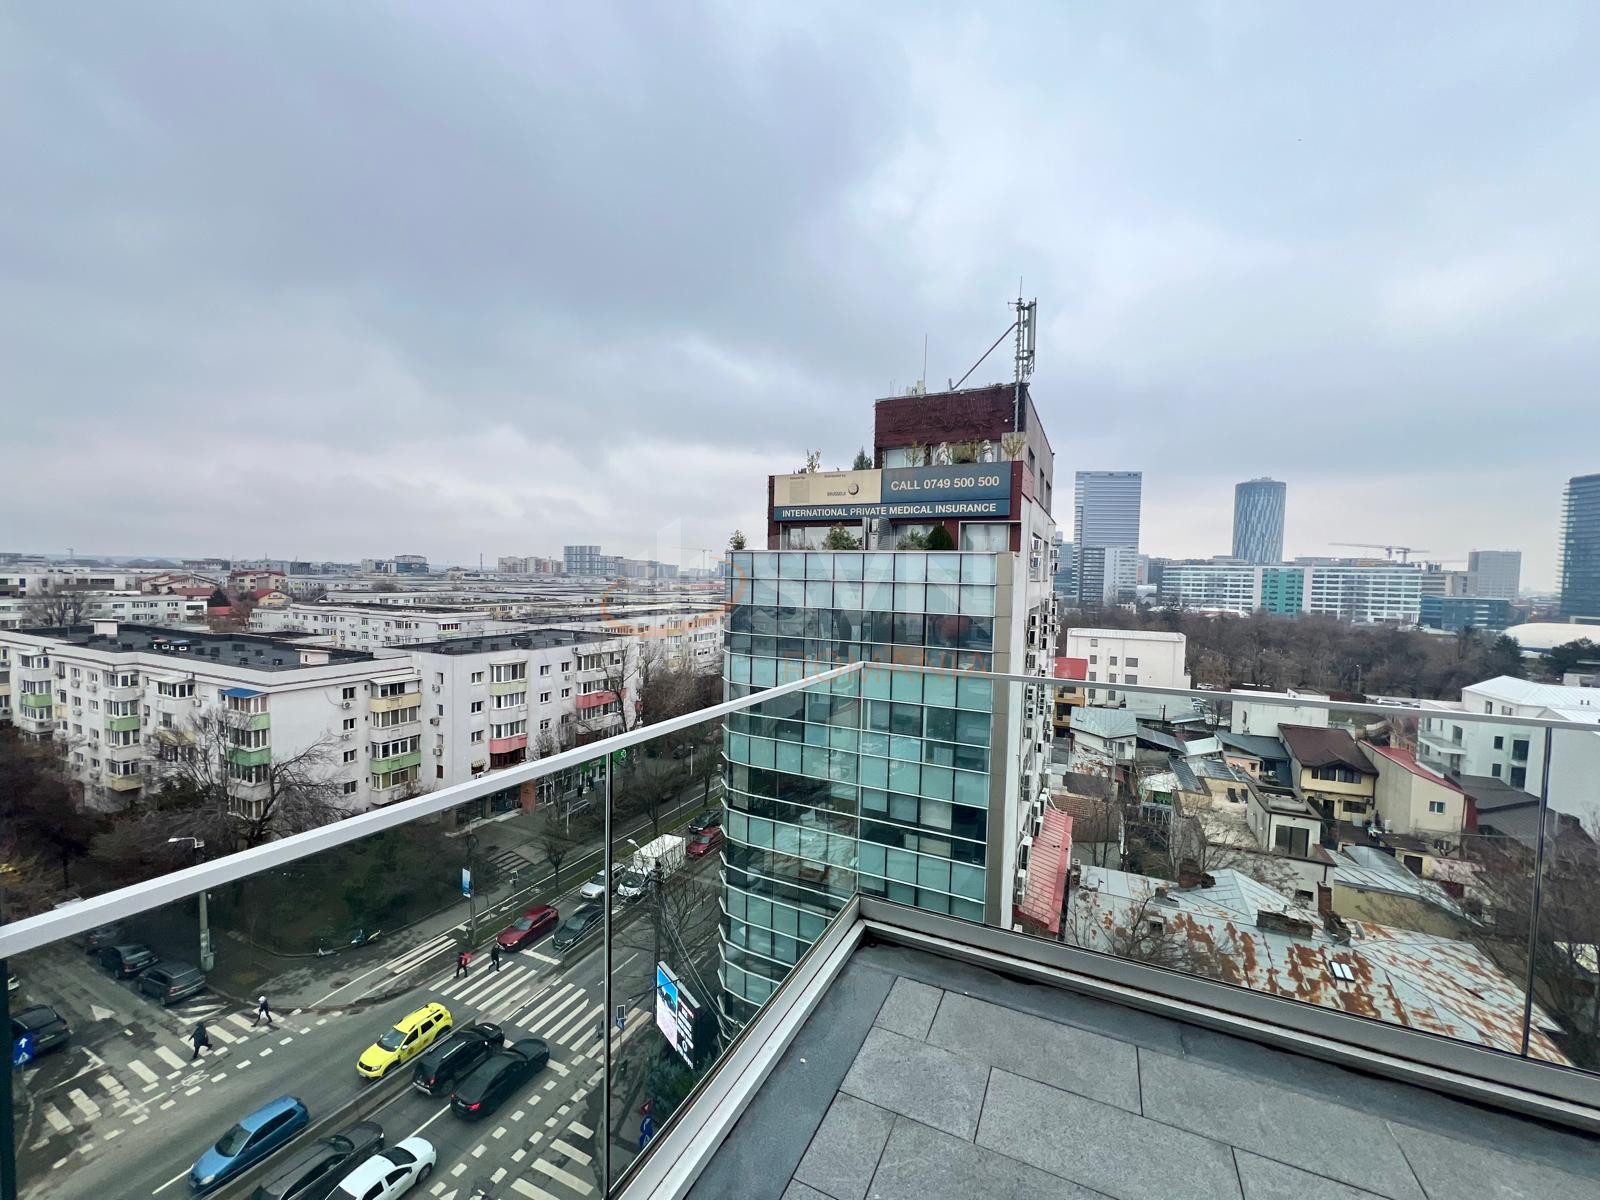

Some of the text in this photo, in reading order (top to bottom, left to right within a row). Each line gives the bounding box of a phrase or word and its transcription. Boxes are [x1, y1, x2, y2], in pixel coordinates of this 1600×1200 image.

[890, 475, 1000, 491] CALL 0749 500 500
[782, 503, 997, 518] INTERNATIONAL PRIVATE MEDICAL INSURANCE
